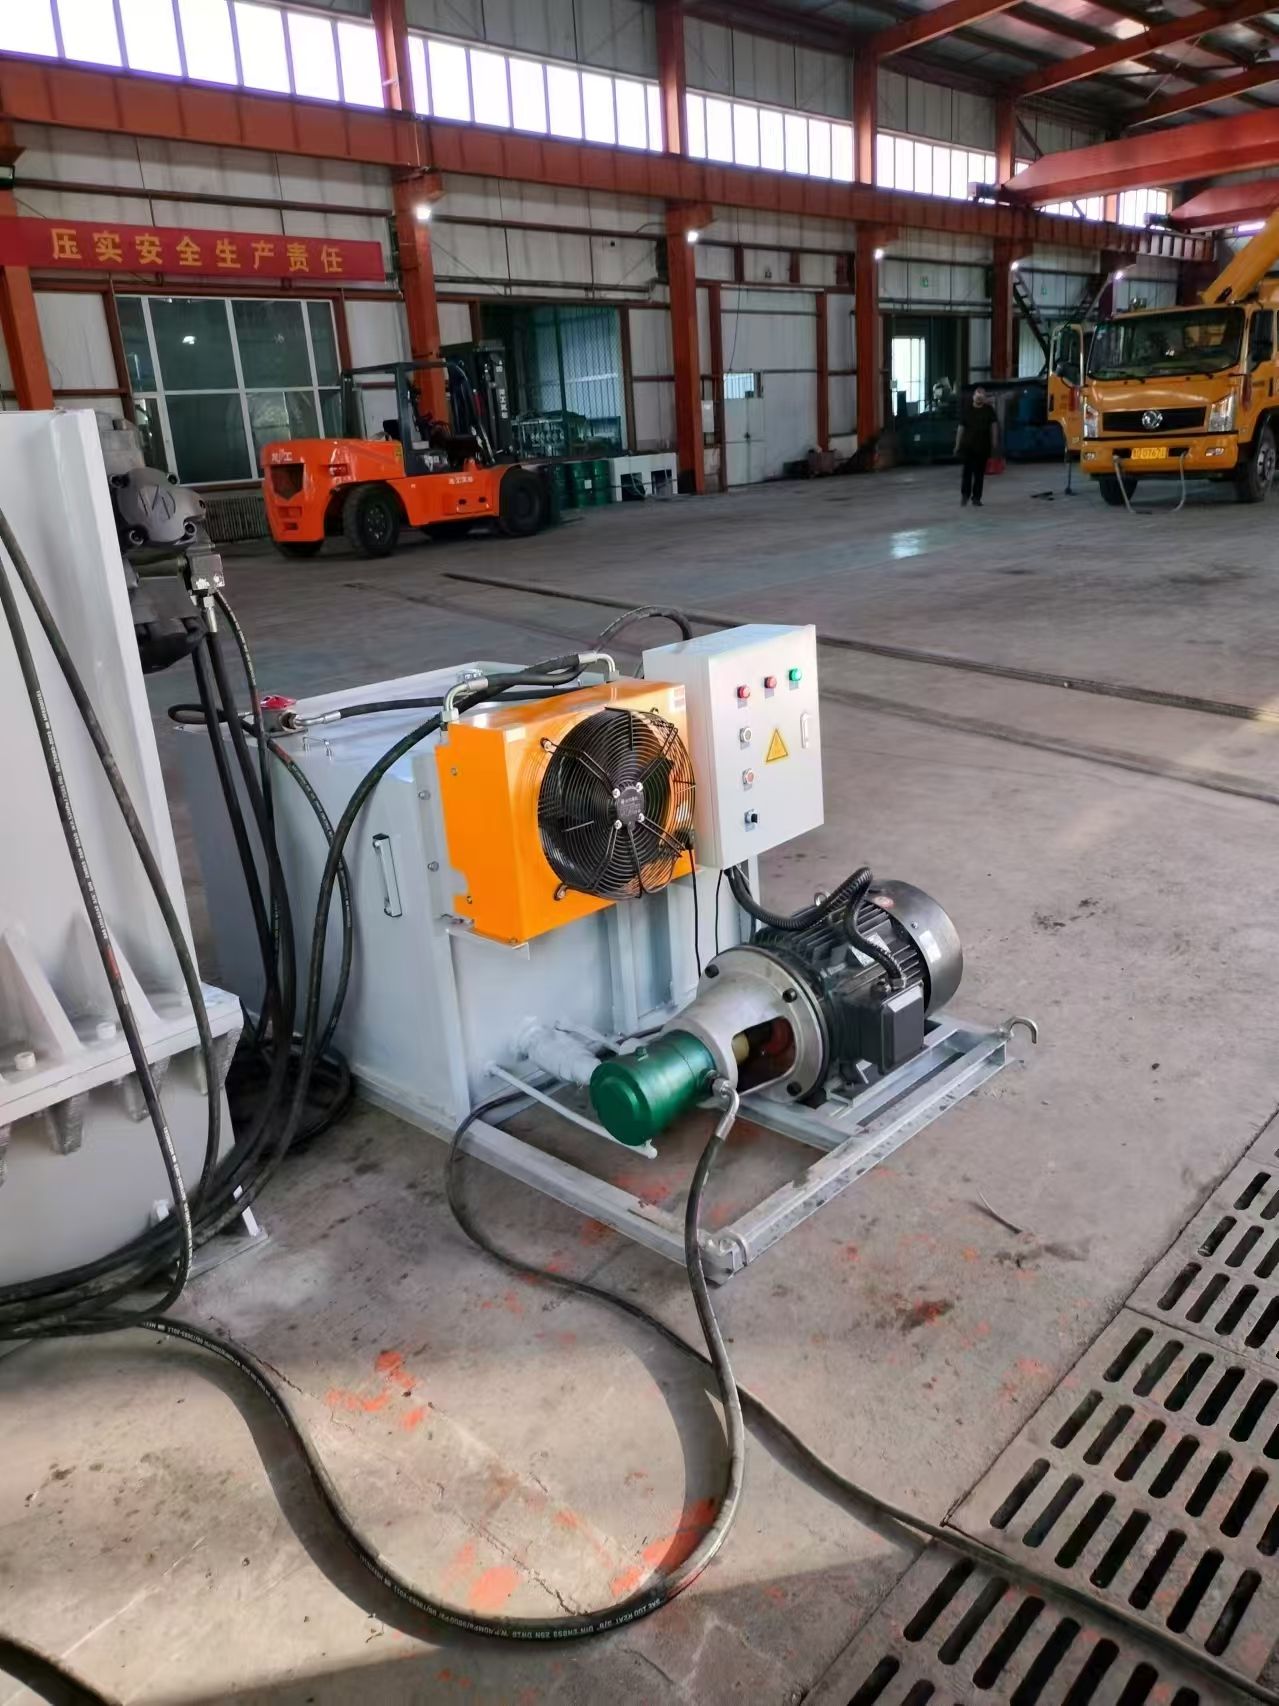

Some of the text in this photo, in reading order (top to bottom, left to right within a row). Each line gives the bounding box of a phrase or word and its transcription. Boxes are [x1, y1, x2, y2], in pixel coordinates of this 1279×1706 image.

[51, 228, 344, 273] 压实安全生产责任
